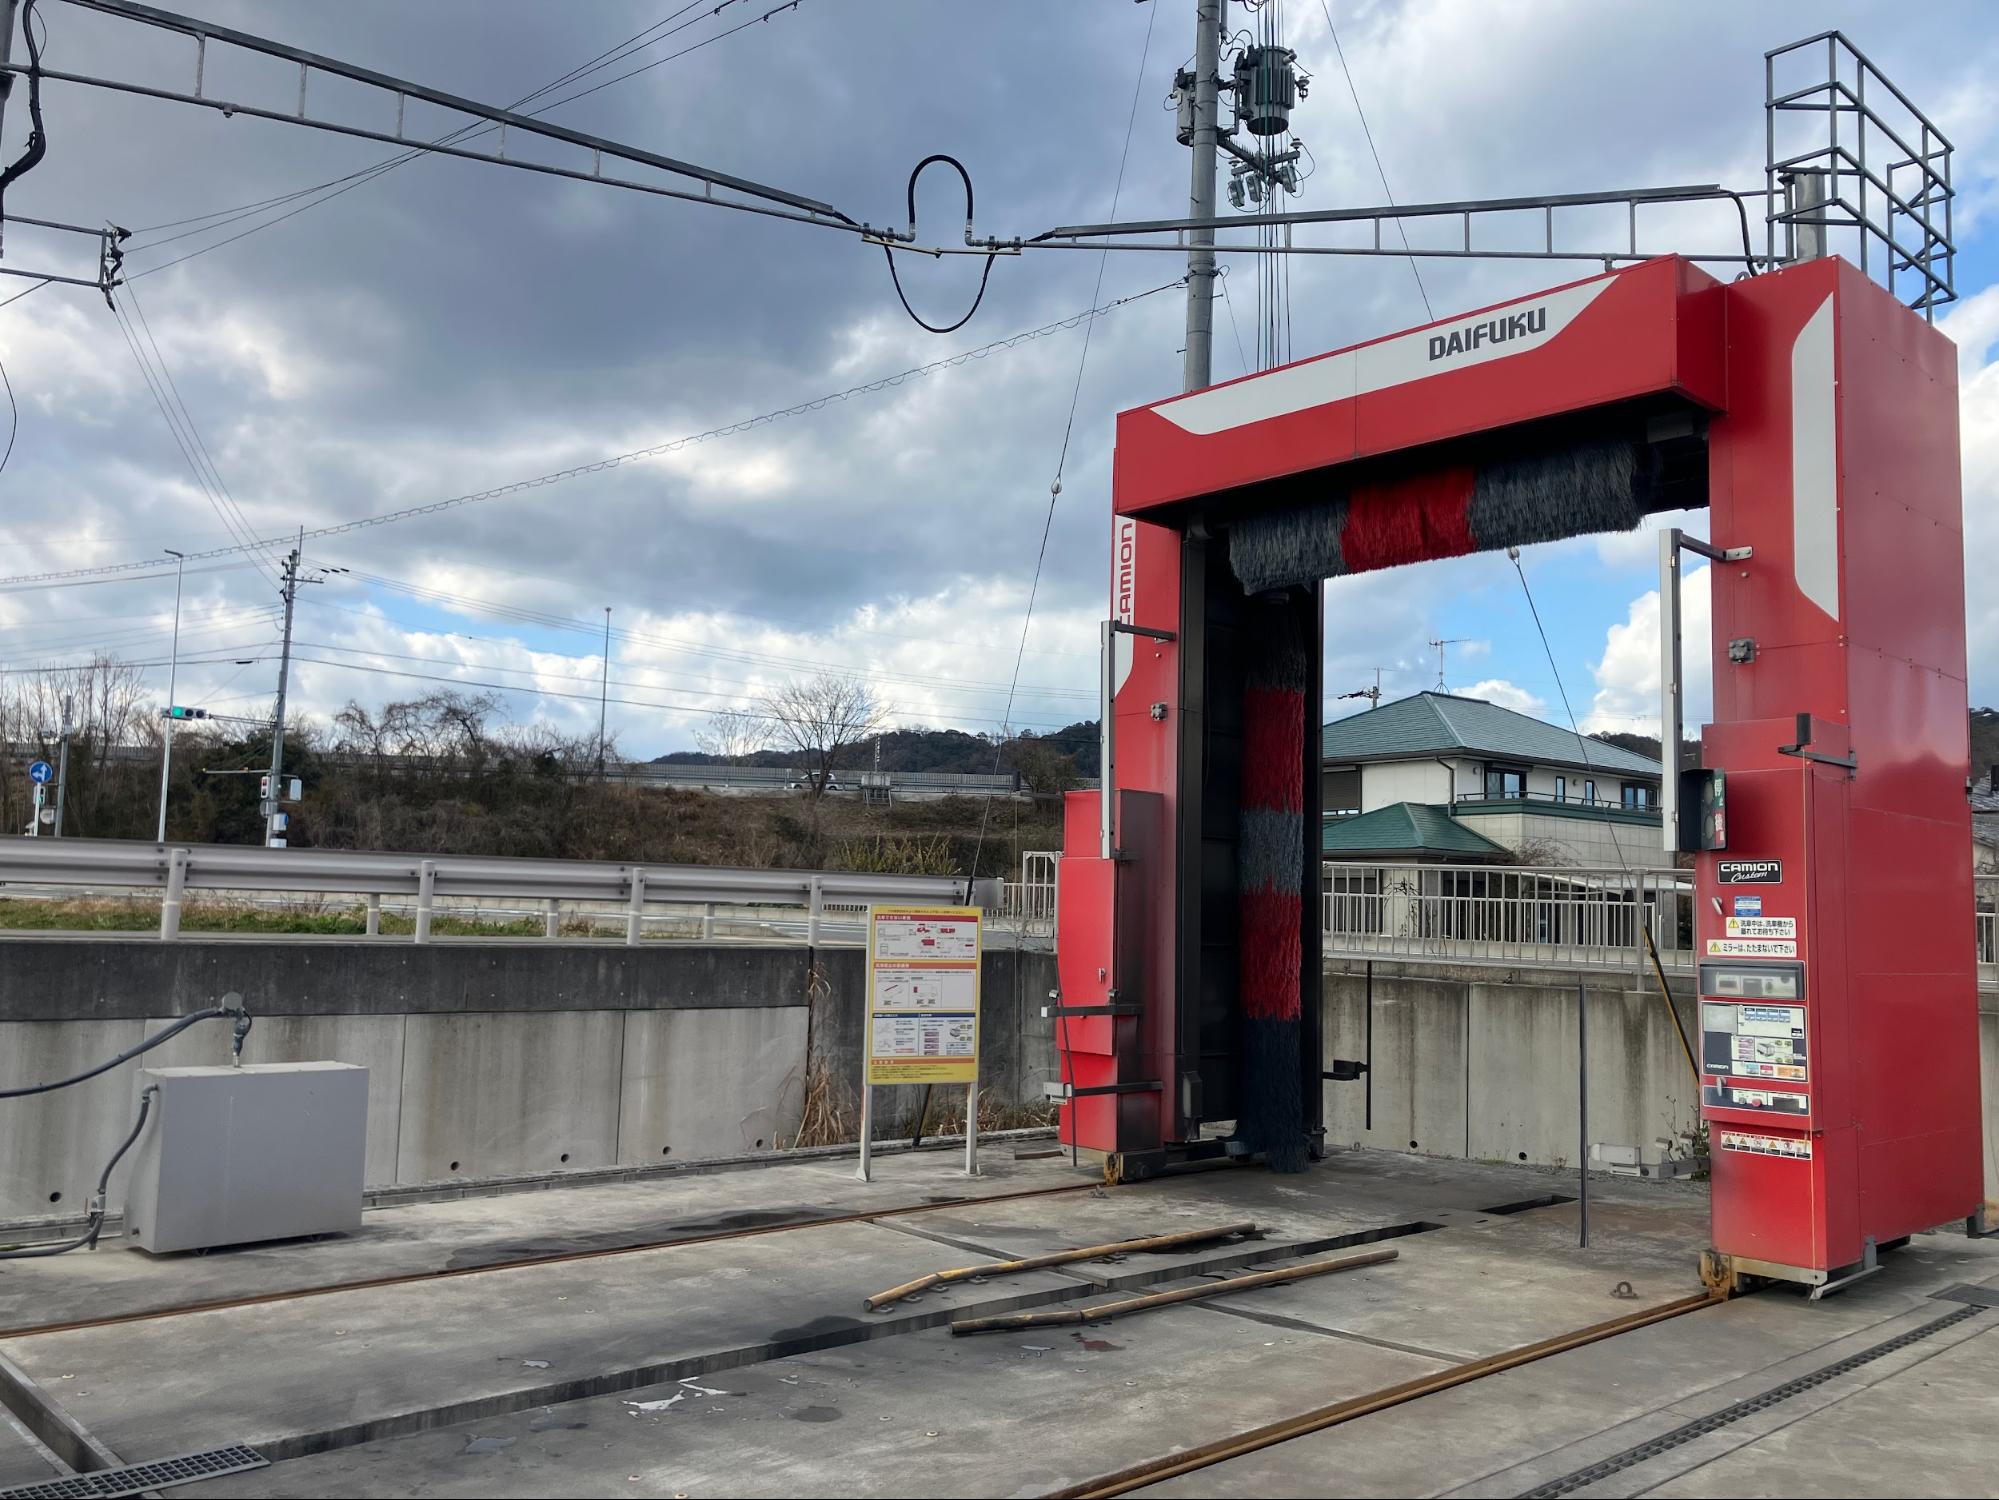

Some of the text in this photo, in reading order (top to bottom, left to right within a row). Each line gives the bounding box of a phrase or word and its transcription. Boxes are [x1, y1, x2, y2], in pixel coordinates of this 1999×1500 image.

[1429, 306, 1546, 361] DAIFUKU
[1720, 863, 1779, 872] CAMION
[1731, 871, 1768, 882] Custom
[1722, 943, 1795, 954] ミラーは、たたまないで下さい
